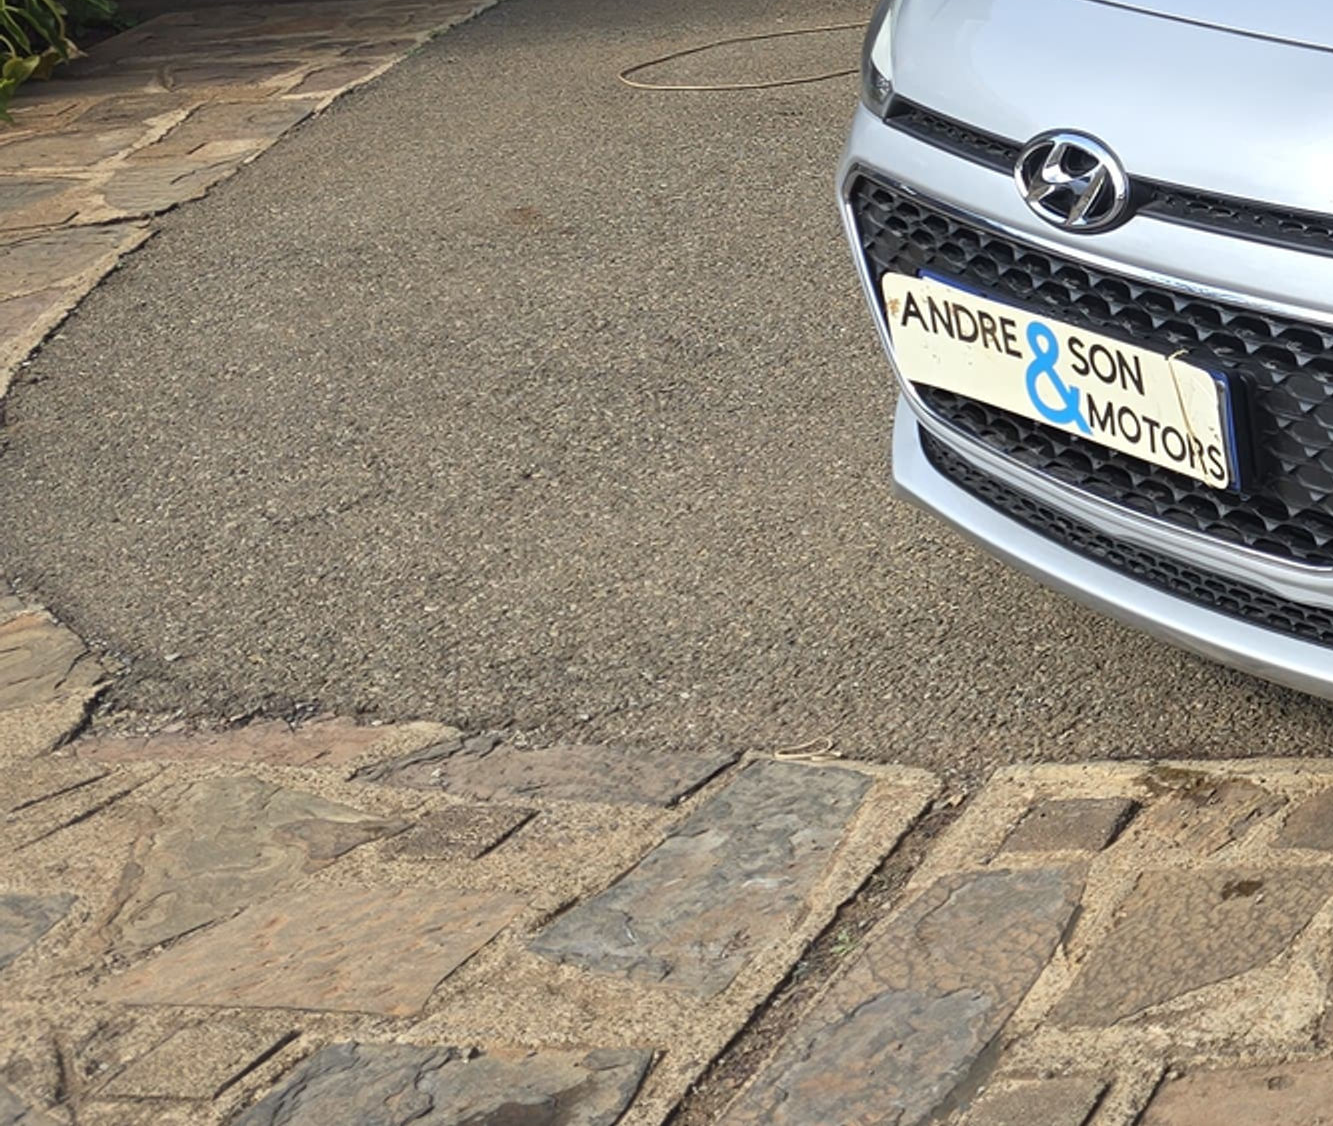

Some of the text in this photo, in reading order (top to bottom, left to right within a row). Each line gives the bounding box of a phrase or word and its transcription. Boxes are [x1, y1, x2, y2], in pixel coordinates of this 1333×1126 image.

[901, 291, 1145, 435] ANDRE & SON
[1087, 393, 1225, 481] MOTORS
